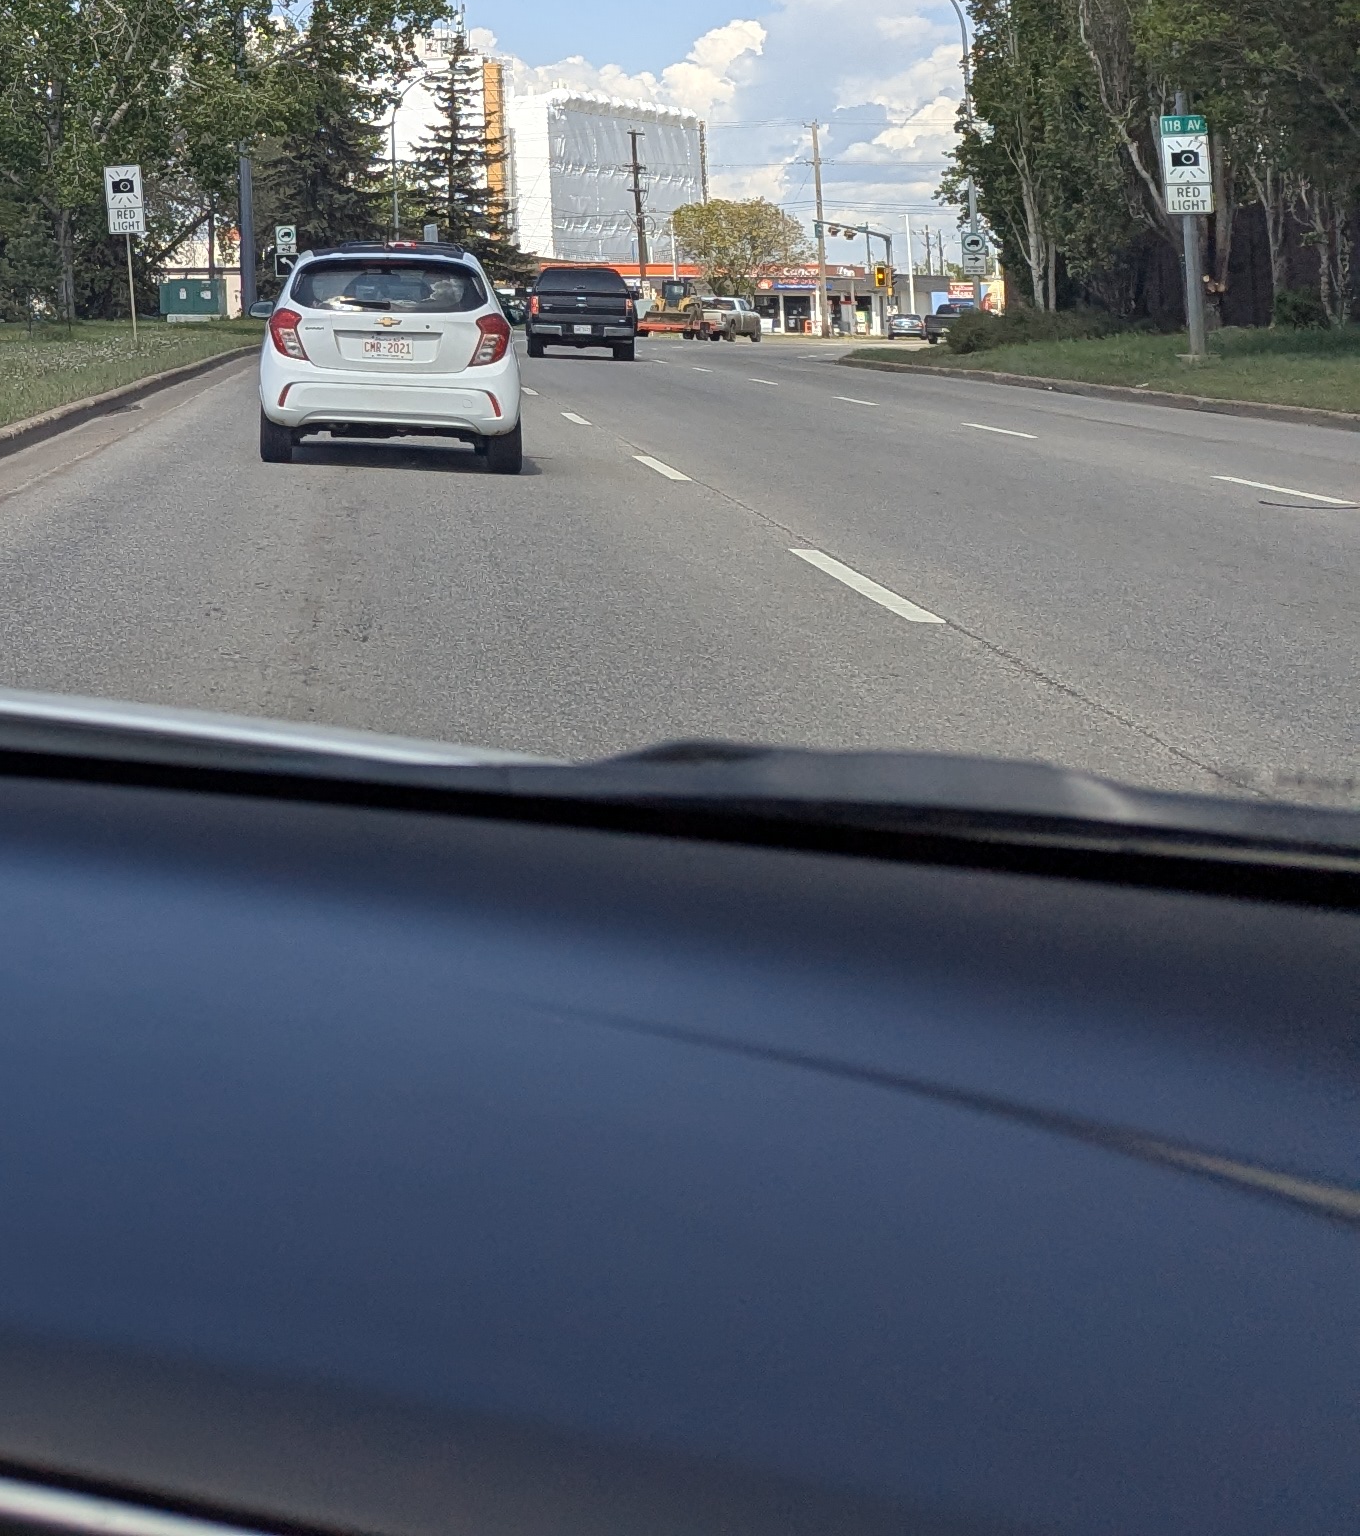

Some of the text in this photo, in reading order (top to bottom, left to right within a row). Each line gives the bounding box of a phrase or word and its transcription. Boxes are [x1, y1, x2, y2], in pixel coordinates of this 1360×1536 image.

[1164, 119, 1201, 132] 118 AV
[1176, 186, 1201, 198] RED
[1171, 199, 1207, 211] LIGHT
[116, 209, 136, 220] RED
[112, 220, 141, 231] LIGHT
